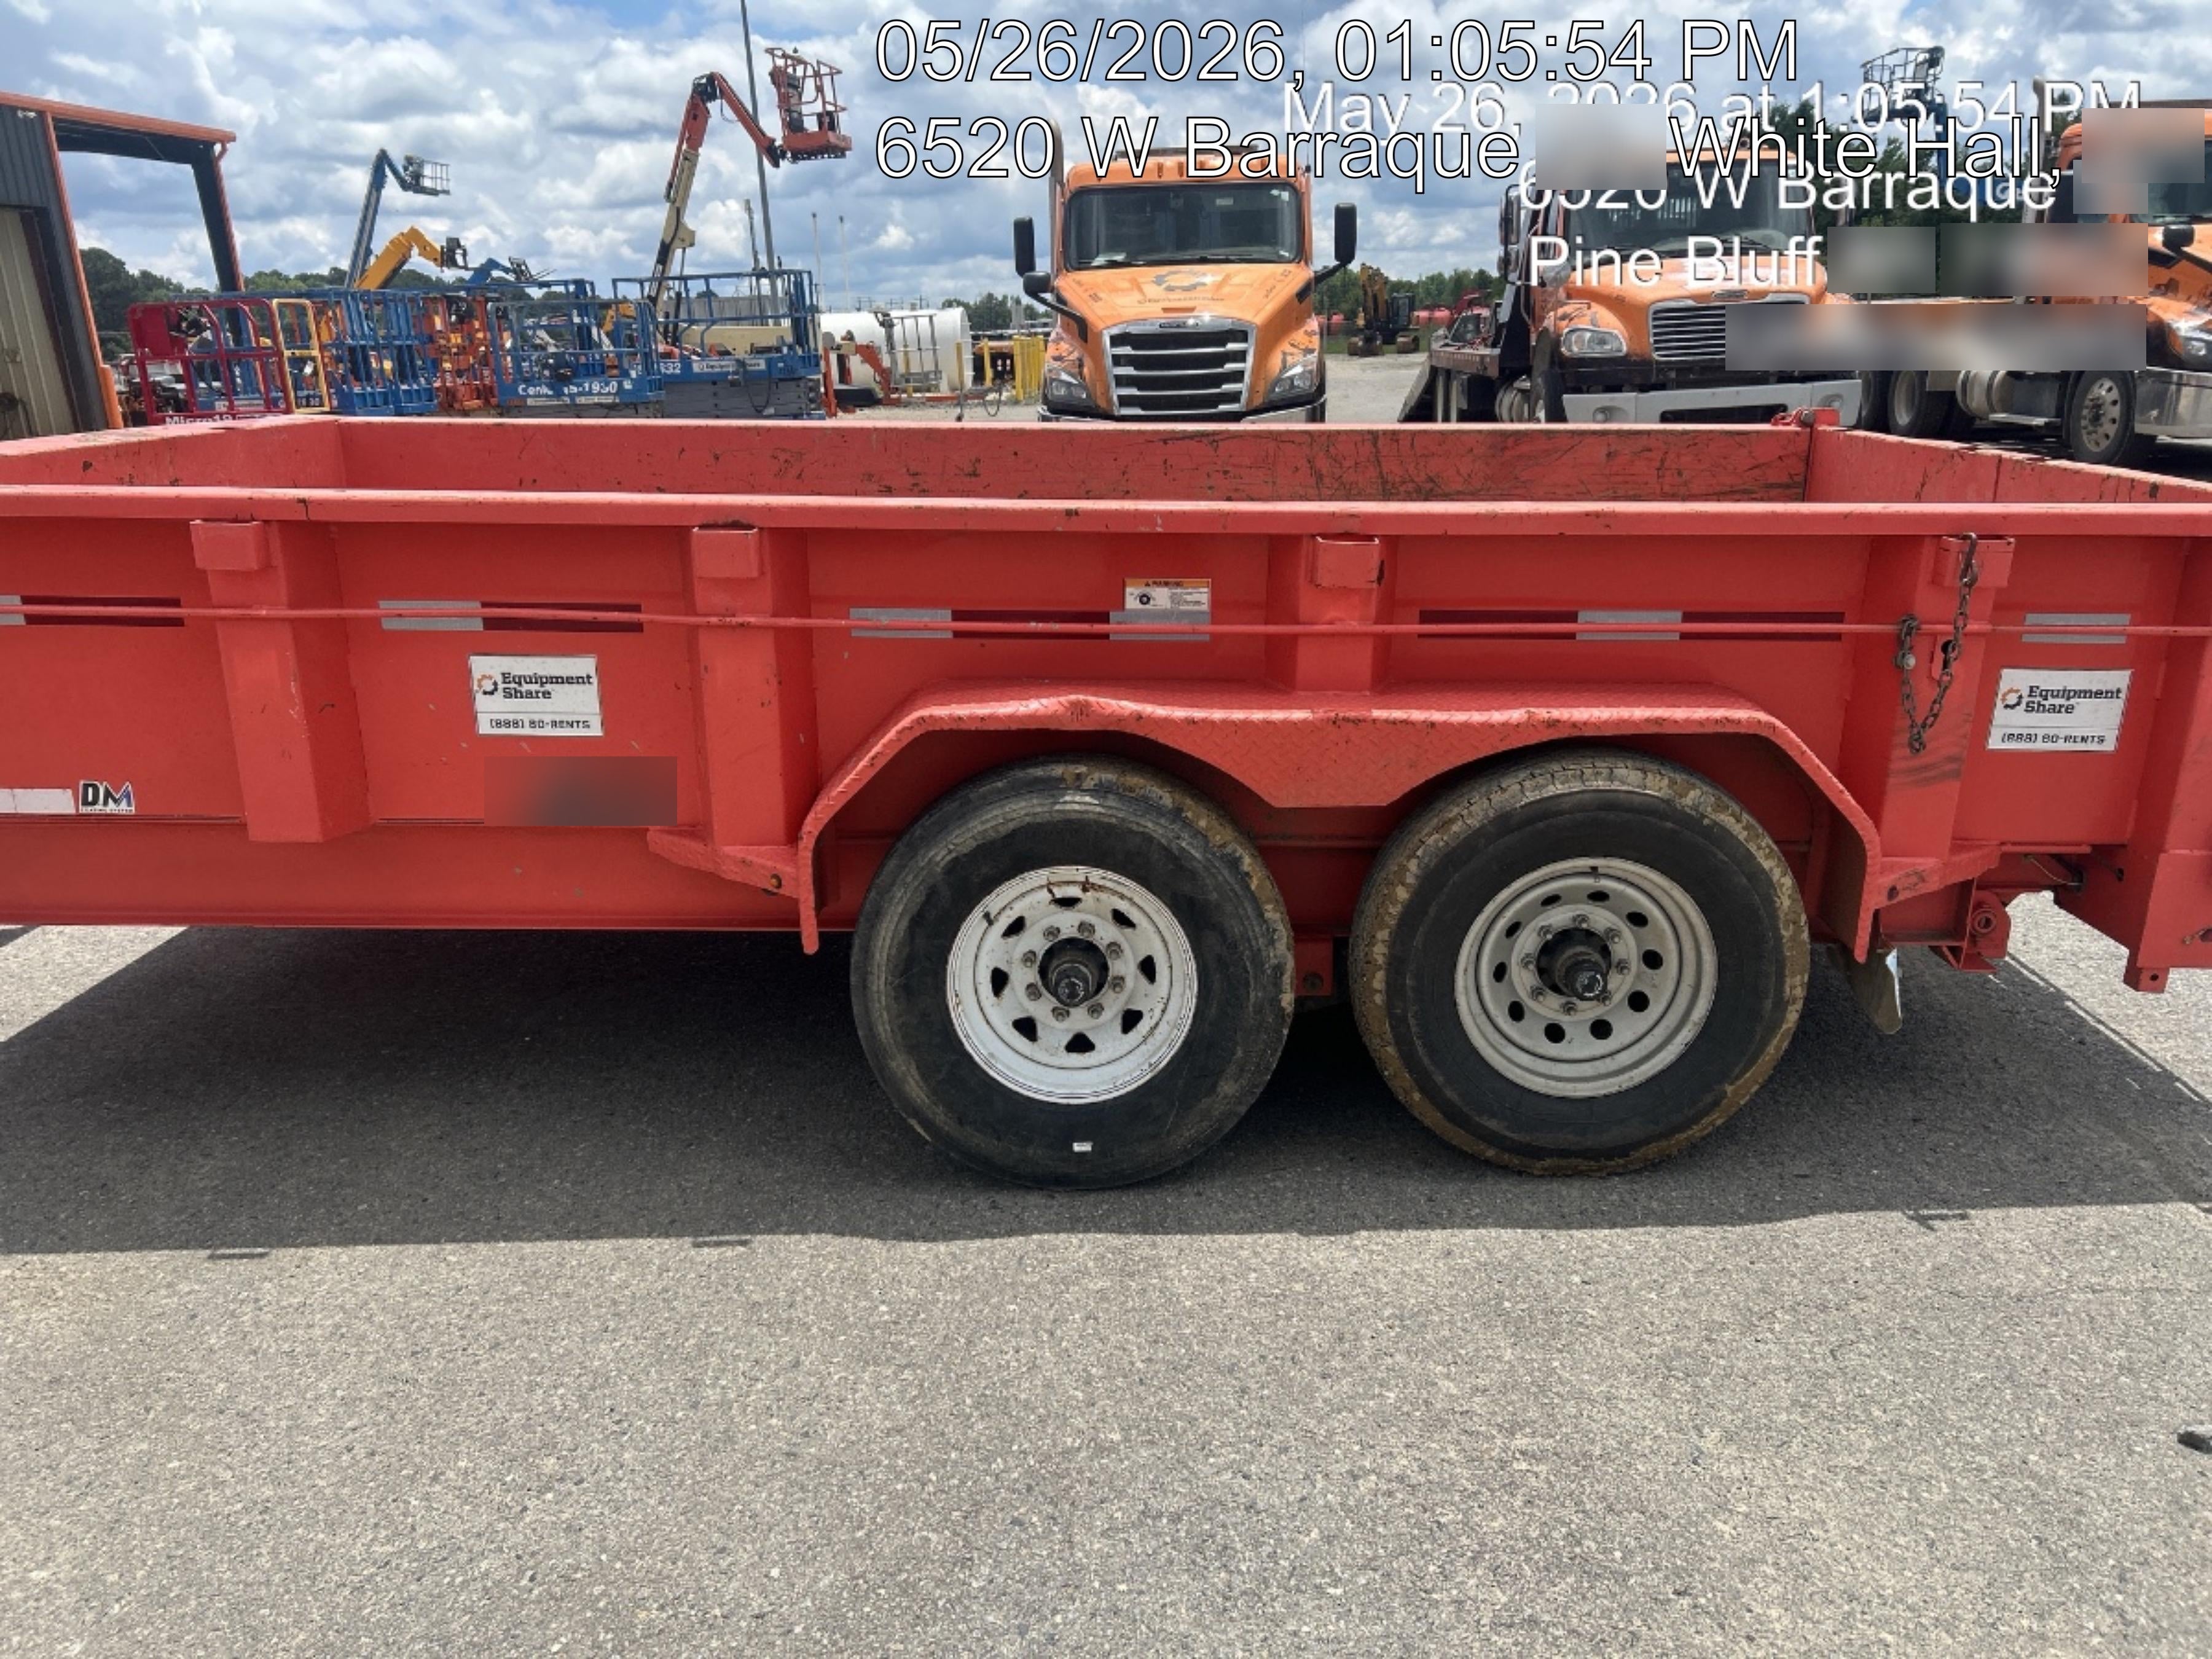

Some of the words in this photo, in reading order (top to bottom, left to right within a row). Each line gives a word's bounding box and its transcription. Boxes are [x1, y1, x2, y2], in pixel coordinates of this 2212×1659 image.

[501, 672, 593, 687] Equipment
[503, 687, 552, 699] Share
[2027, 685, 2122, 701] Equipment
[2023, 700, 2074, 714] Share
[528, 719, 590, 729] 80-RENTS
[81, 782, 133, 807] DM
